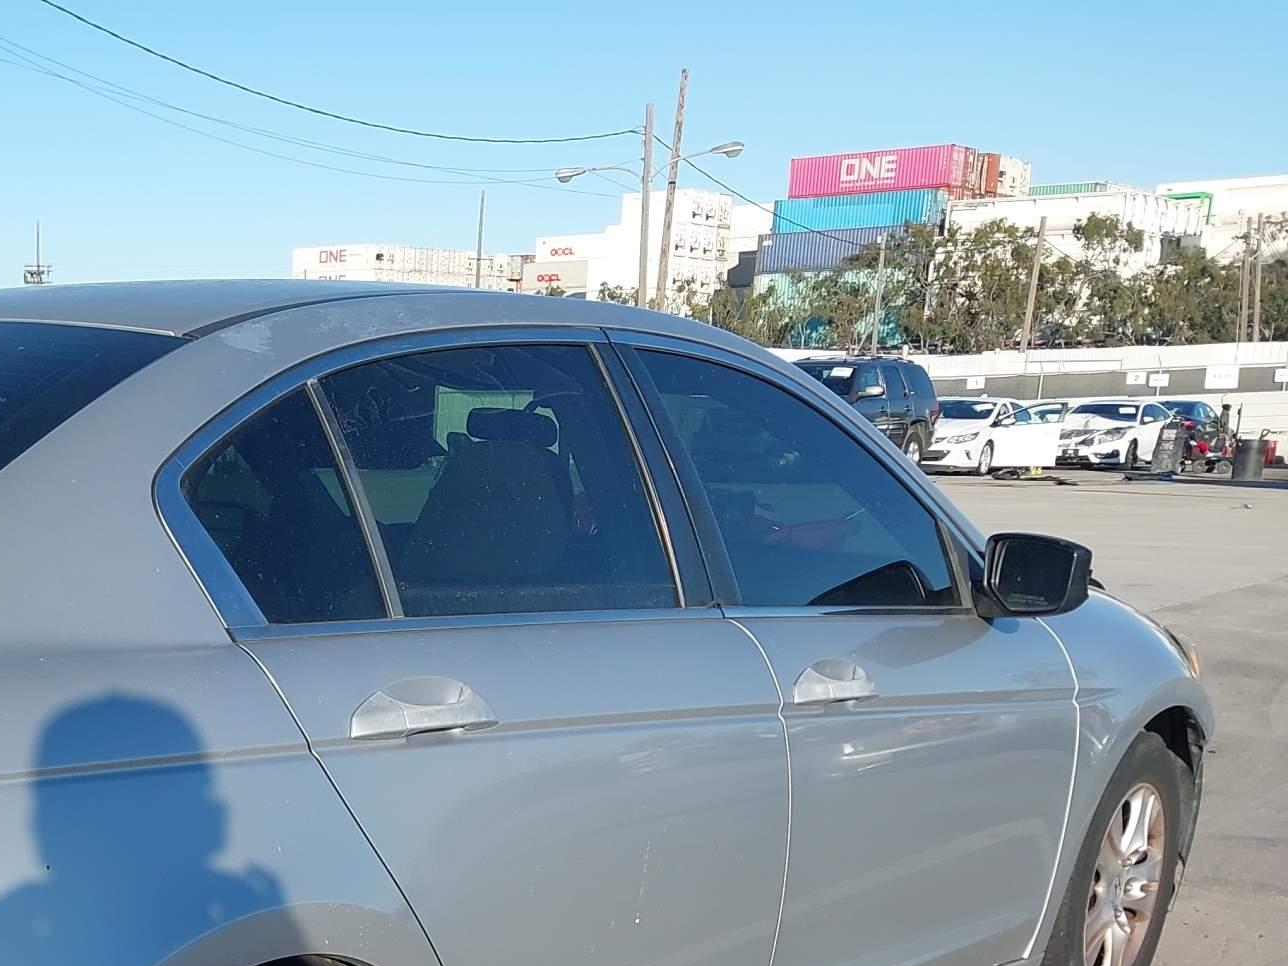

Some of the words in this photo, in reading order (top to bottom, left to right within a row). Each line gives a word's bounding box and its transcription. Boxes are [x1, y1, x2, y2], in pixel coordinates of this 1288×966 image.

[840, 155, 897, 181] ONE
[319, 249, 347, 263] ONE
[550, 248, 575, 256] OOCL
[536, 274, 562, 282] OOCL
